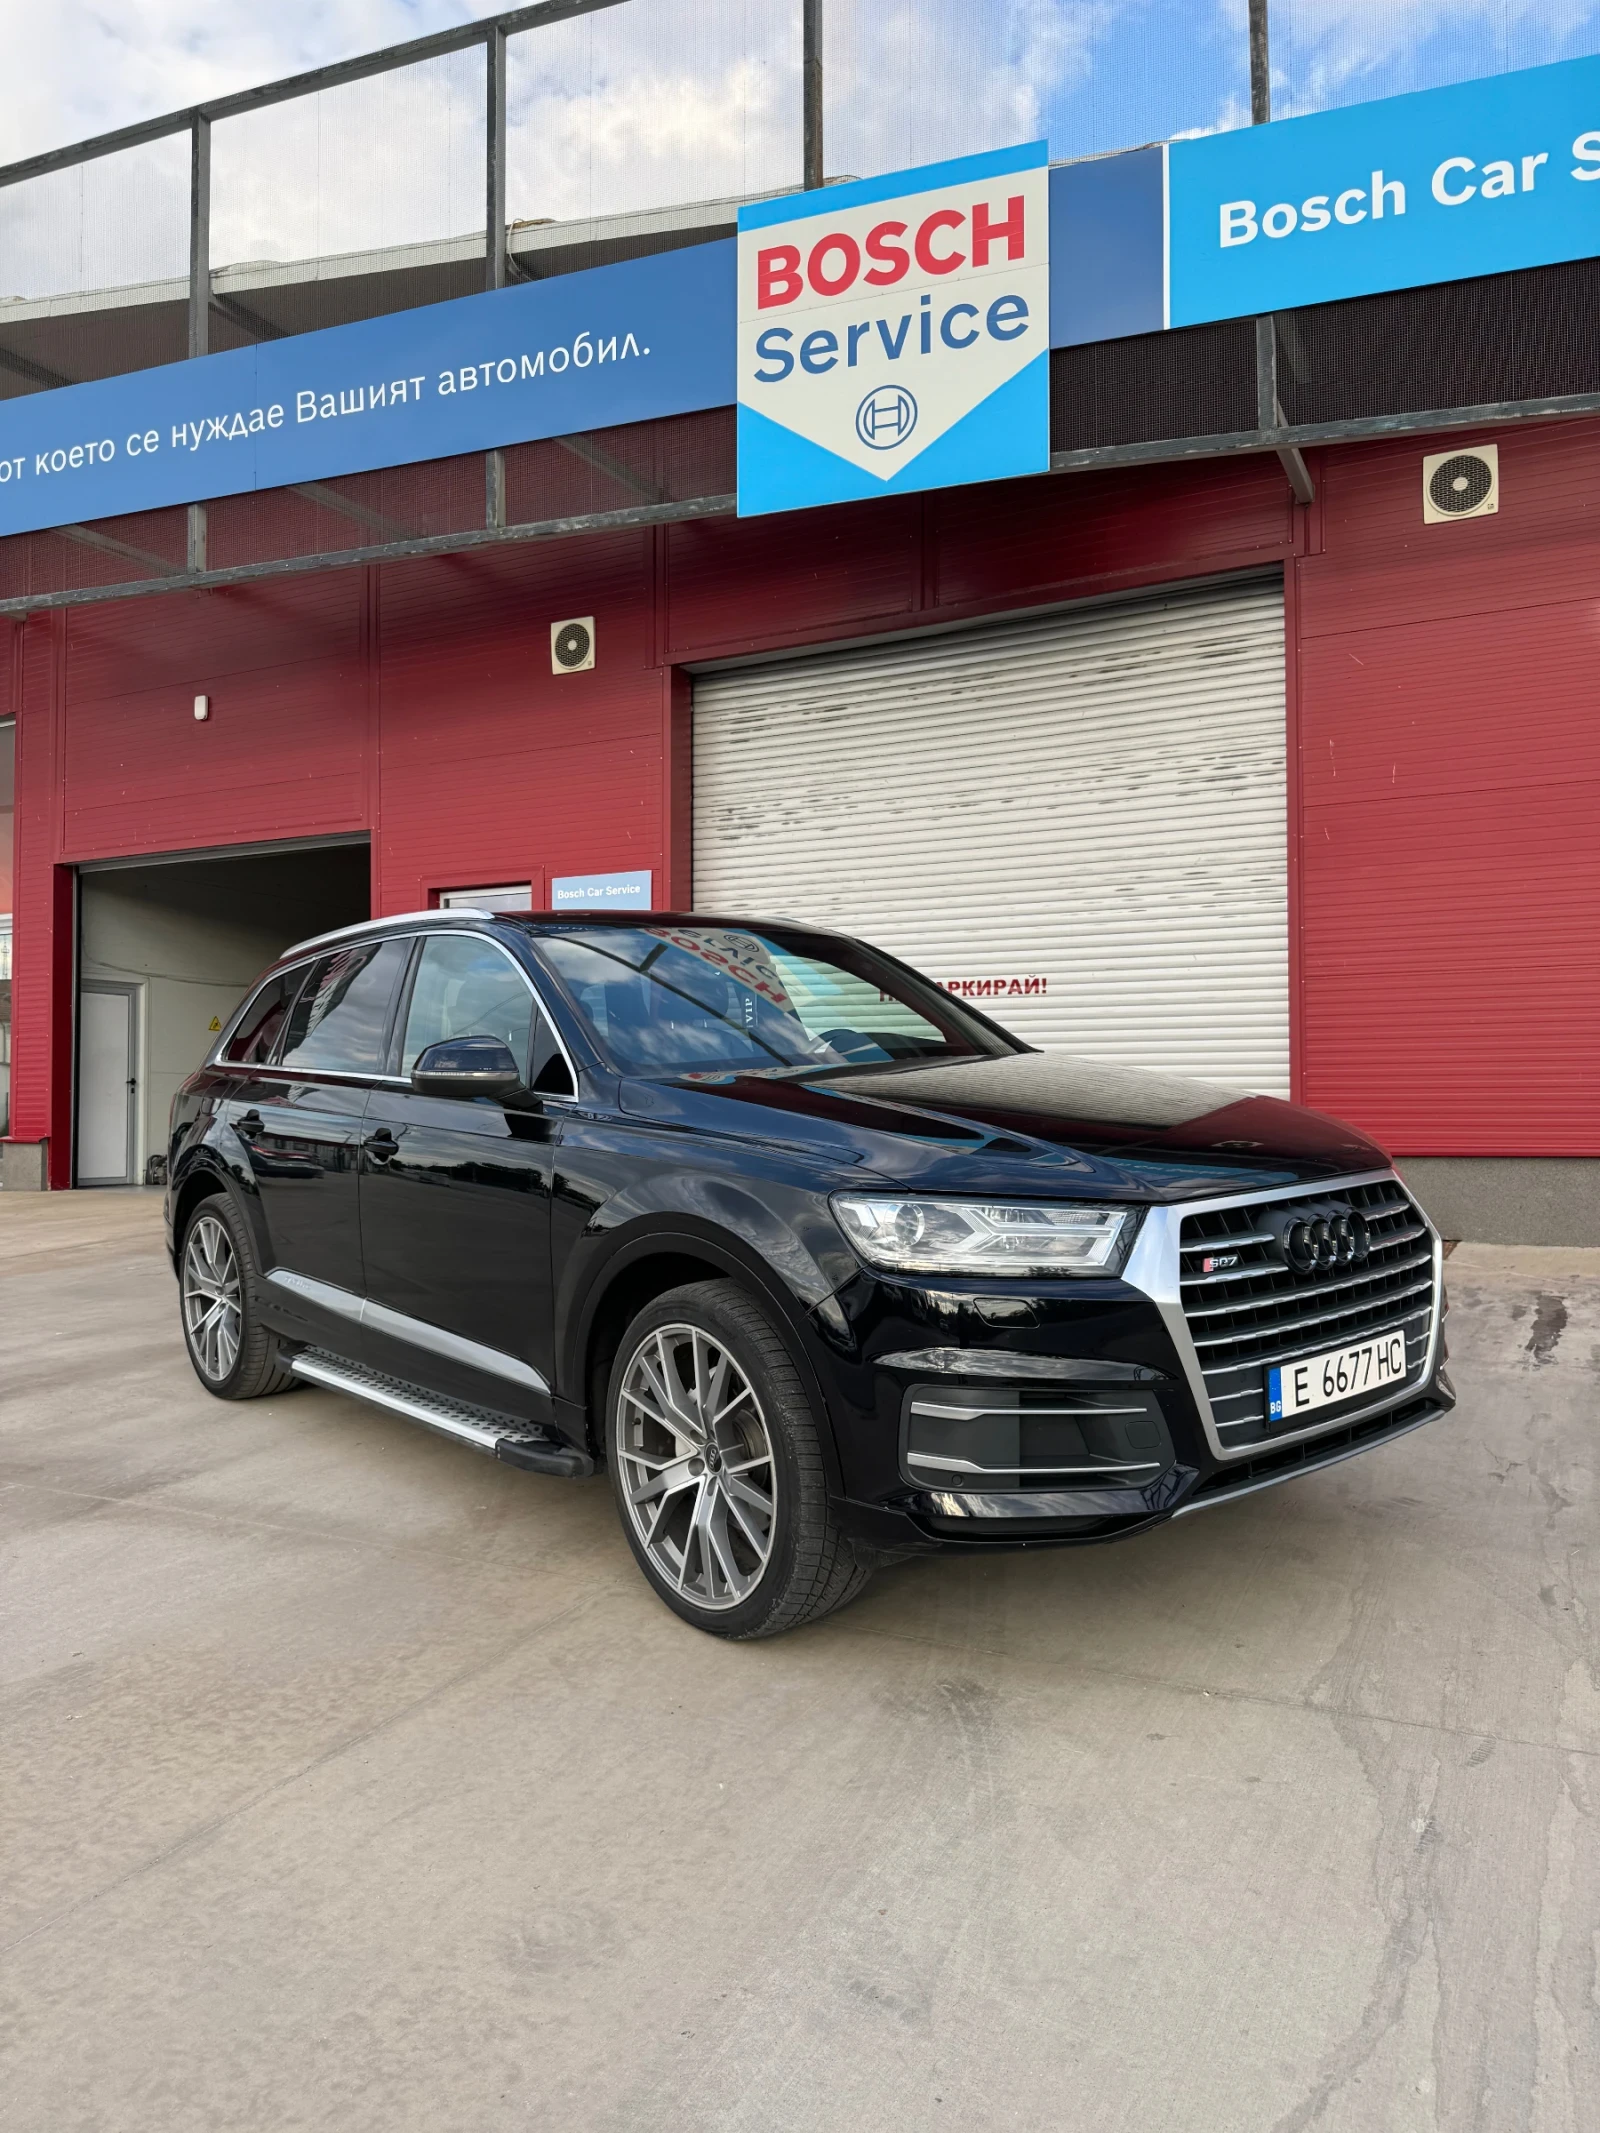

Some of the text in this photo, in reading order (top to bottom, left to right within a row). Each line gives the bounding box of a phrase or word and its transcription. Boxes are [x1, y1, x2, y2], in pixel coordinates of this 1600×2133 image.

[1219, 169, 1407, 249] Bosch
[1431, 152, 1549, 207] Car
[757, 194, 1025, 310] BOSCH
[753, 293, 1029, 383] Service
[0, 330, 651, 483] от което се нуждае Вашият автомобил.
[557, 883, 641, 900] Bosch Car Service
[1269, 1400, 1282, 1415] BG
[1294, 1366, 1310, 1408] E
[1322, 1346, 1373, 1398] 6677
